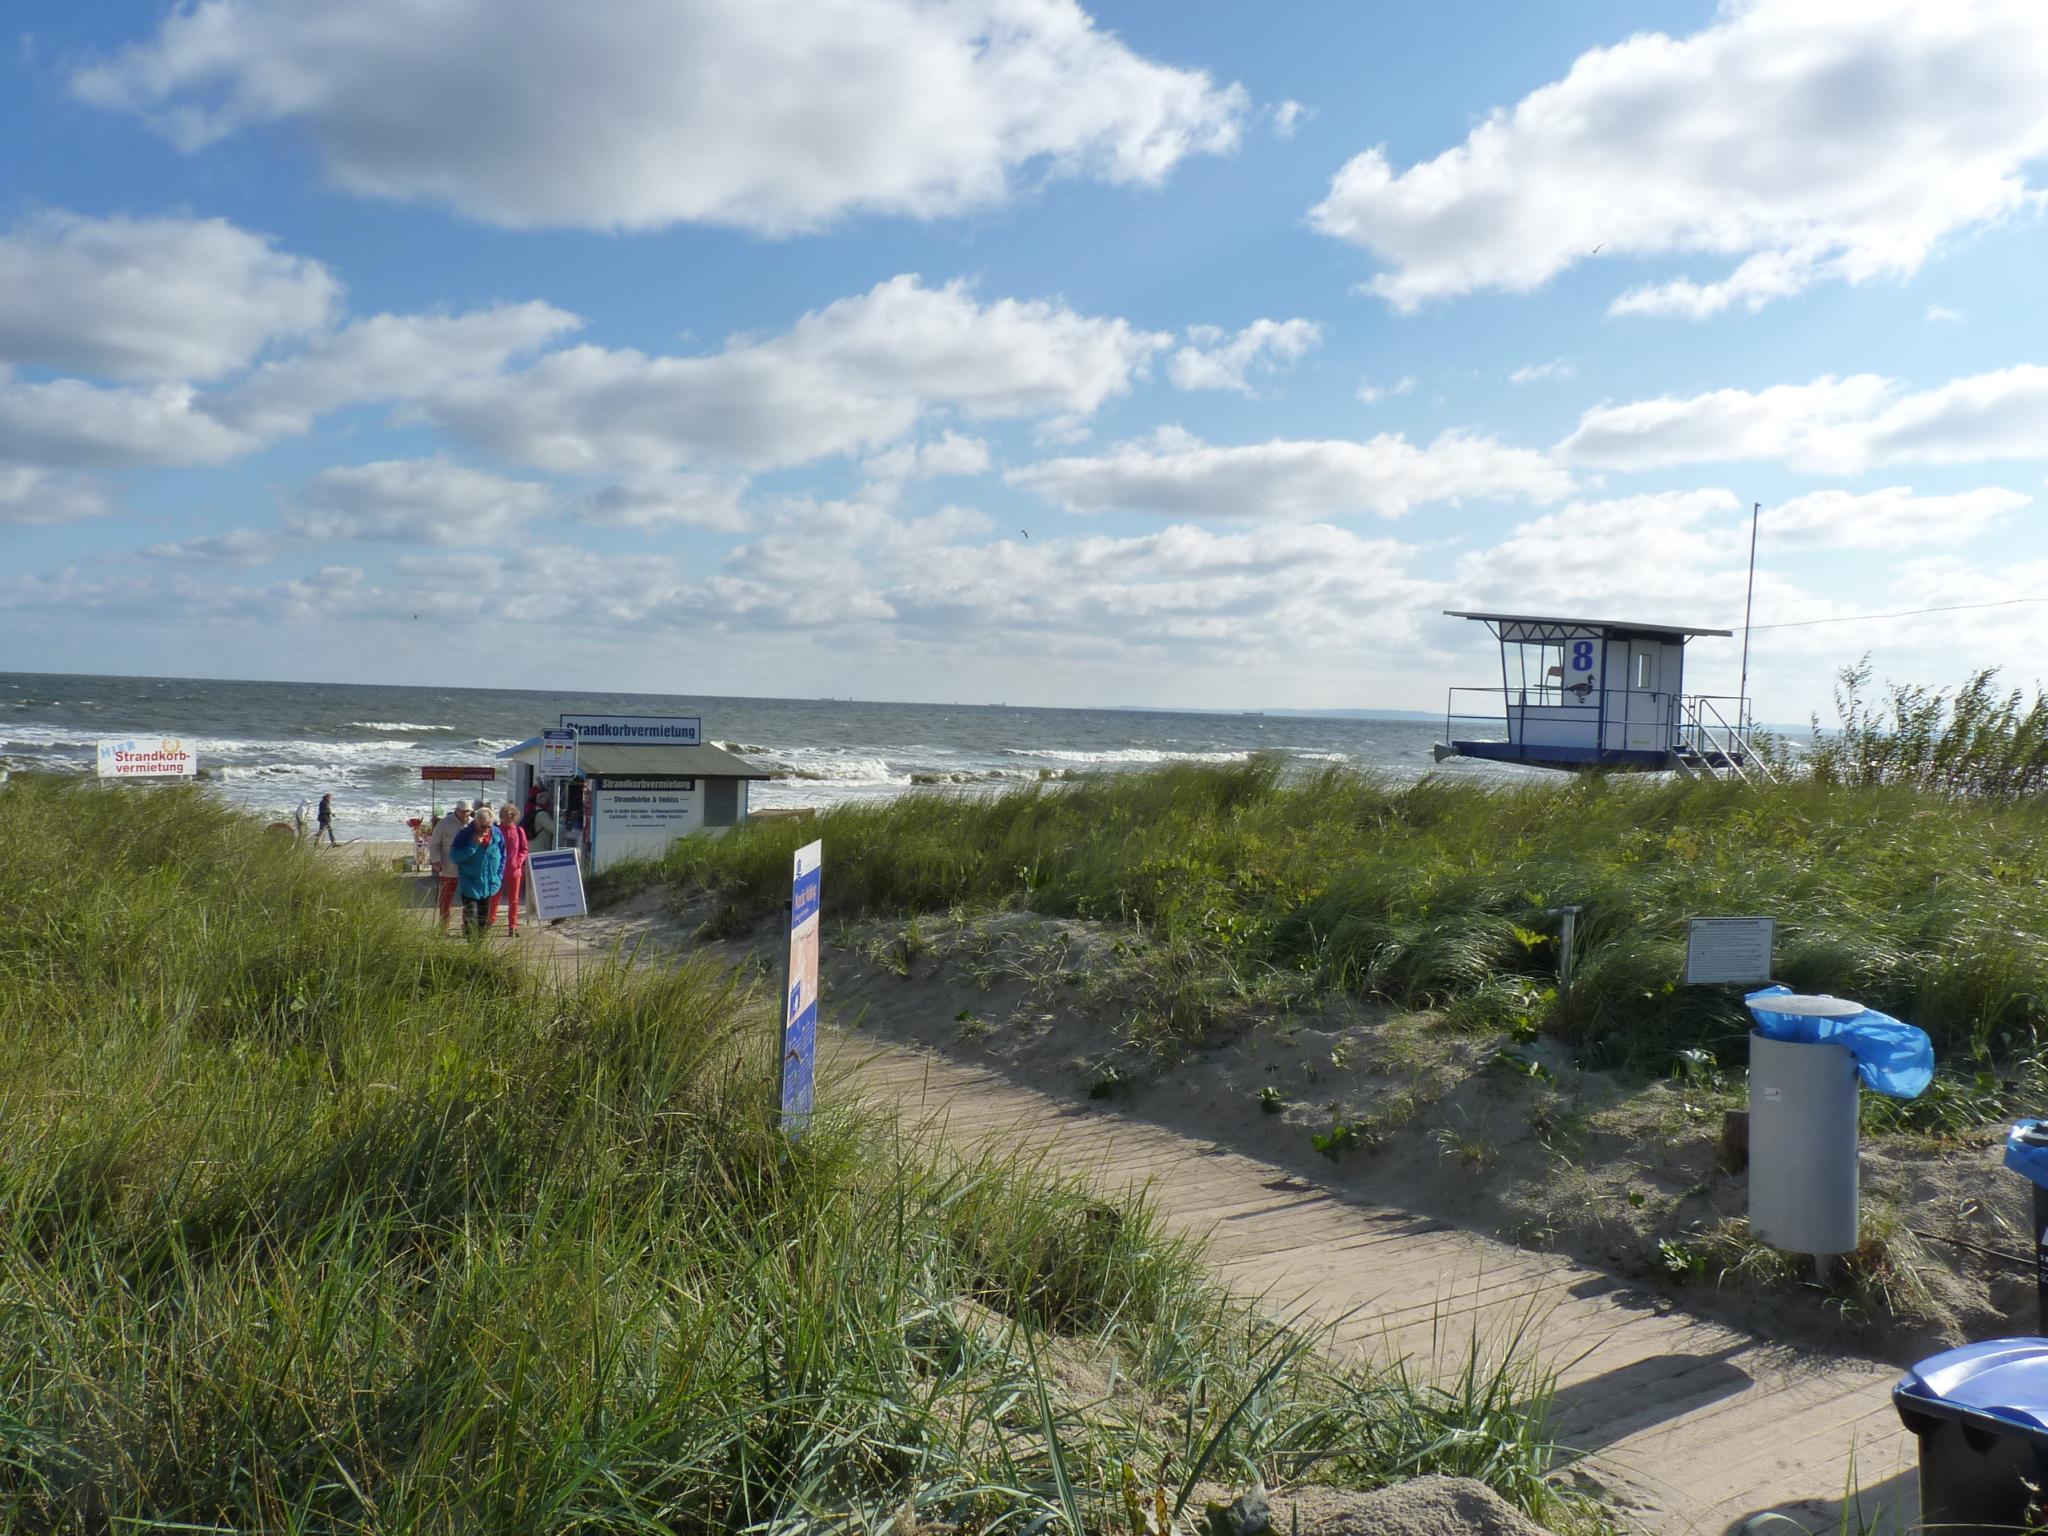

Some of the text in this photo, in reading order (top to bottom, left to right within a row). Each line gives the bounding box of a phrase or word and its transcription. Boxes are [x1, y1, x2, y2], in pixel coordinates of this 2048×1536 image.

[1572, 640, 1593, 671] 8
[100, 740, 136, 758] HIER
[115, 751, 190, 761] Strandkorb-
[116, 763, 183, 773] vermietung
[602, 779, 691, 790] Strandkorbvermietung
